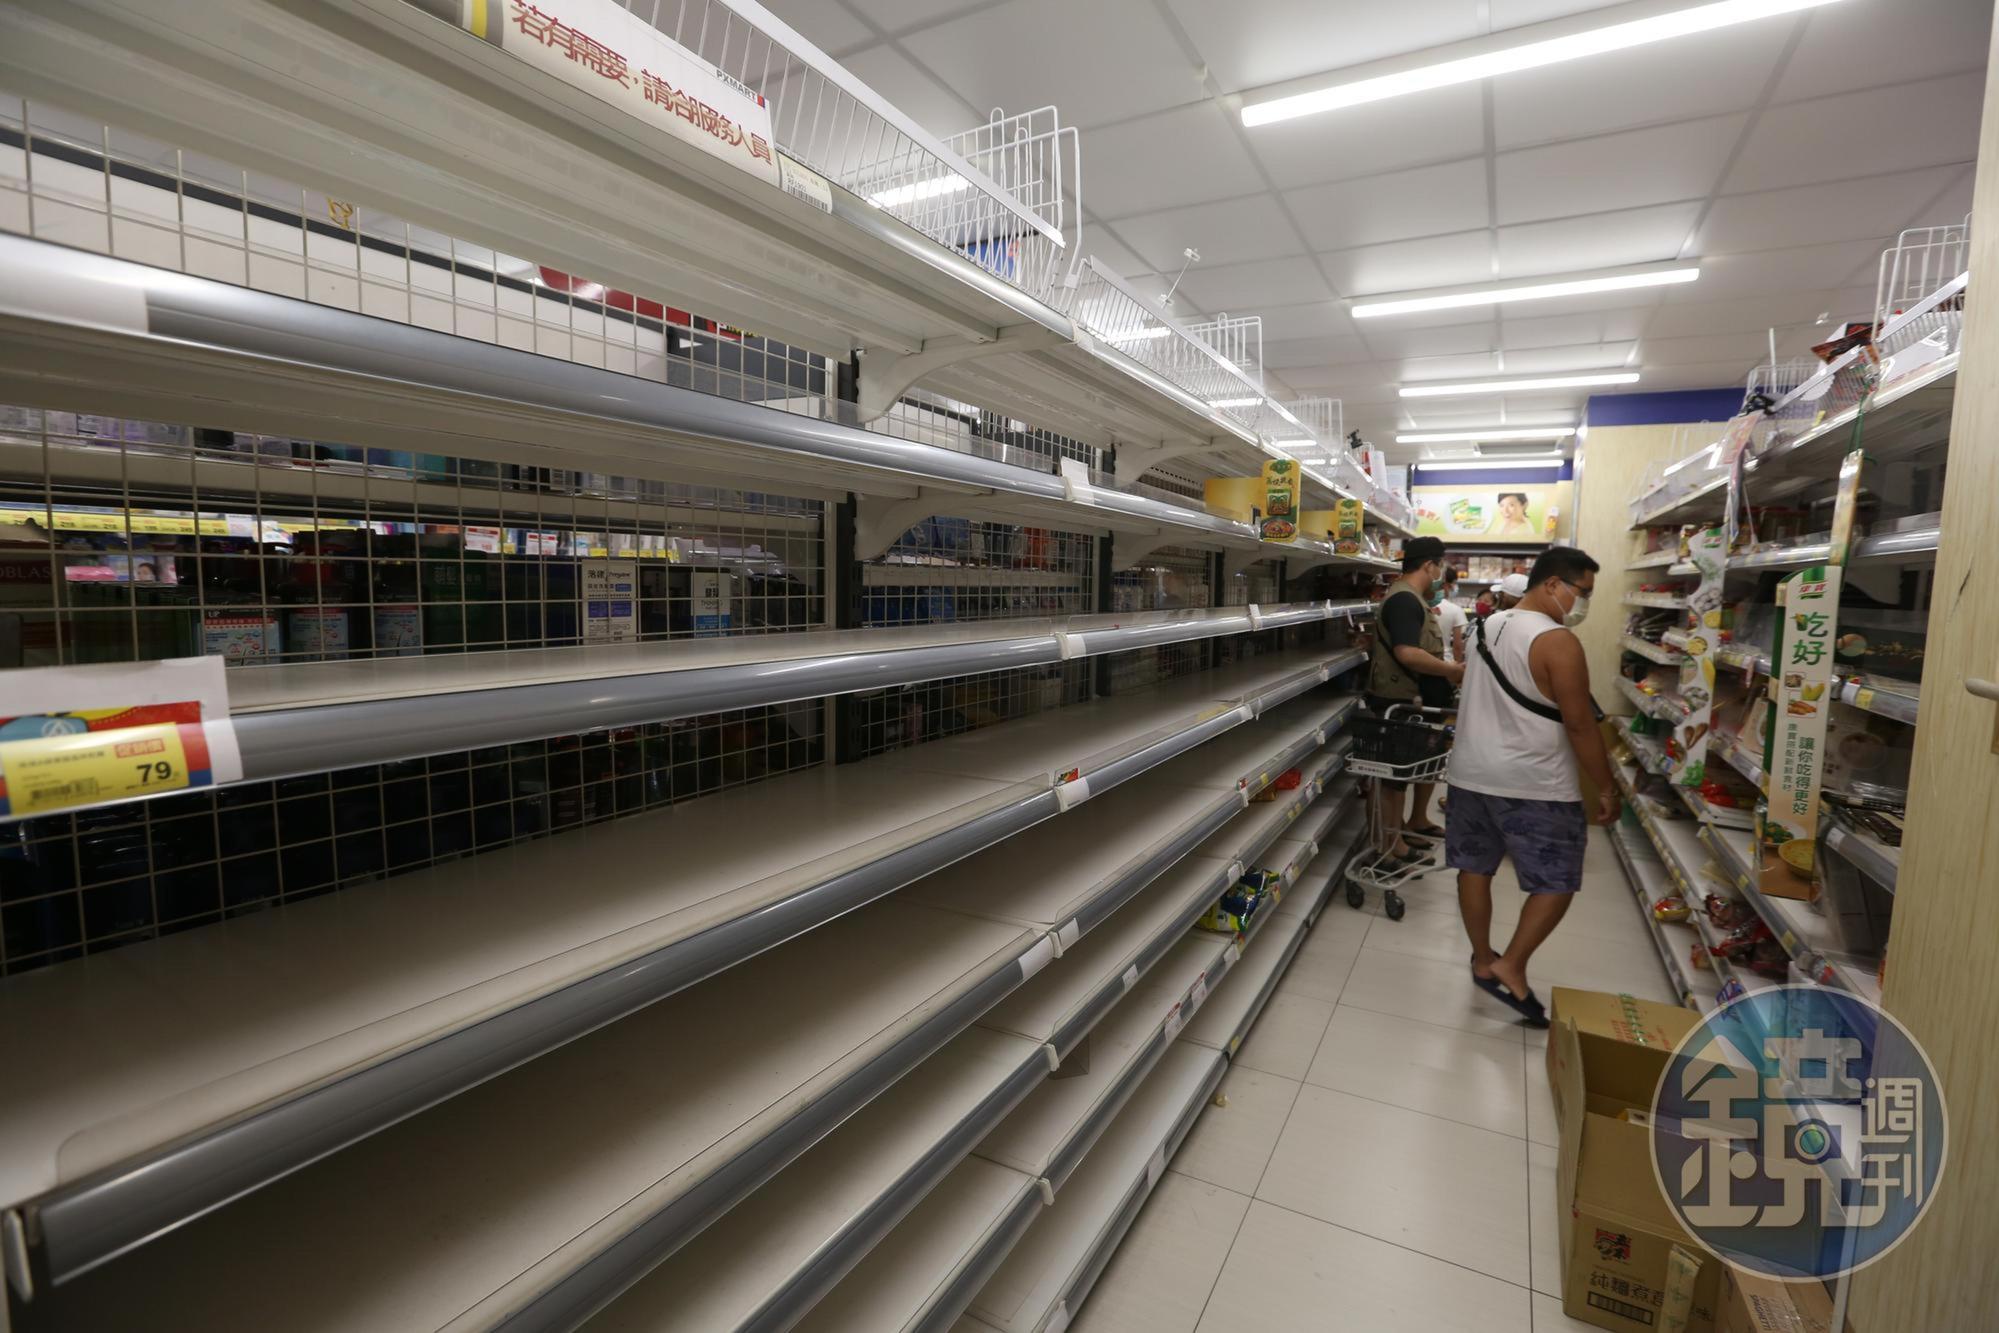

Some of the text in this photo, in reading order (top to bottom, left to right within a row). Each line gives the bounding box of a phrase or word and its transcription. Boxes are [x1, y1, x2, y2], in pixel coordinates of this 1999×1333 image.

[716, 69, 757, 101] PXMART
[1790, 611, 1830, 666] 吃好
[136, 761, 173, 785] 79
[1793, 736, 1816, 816] 讓你吃得更好
